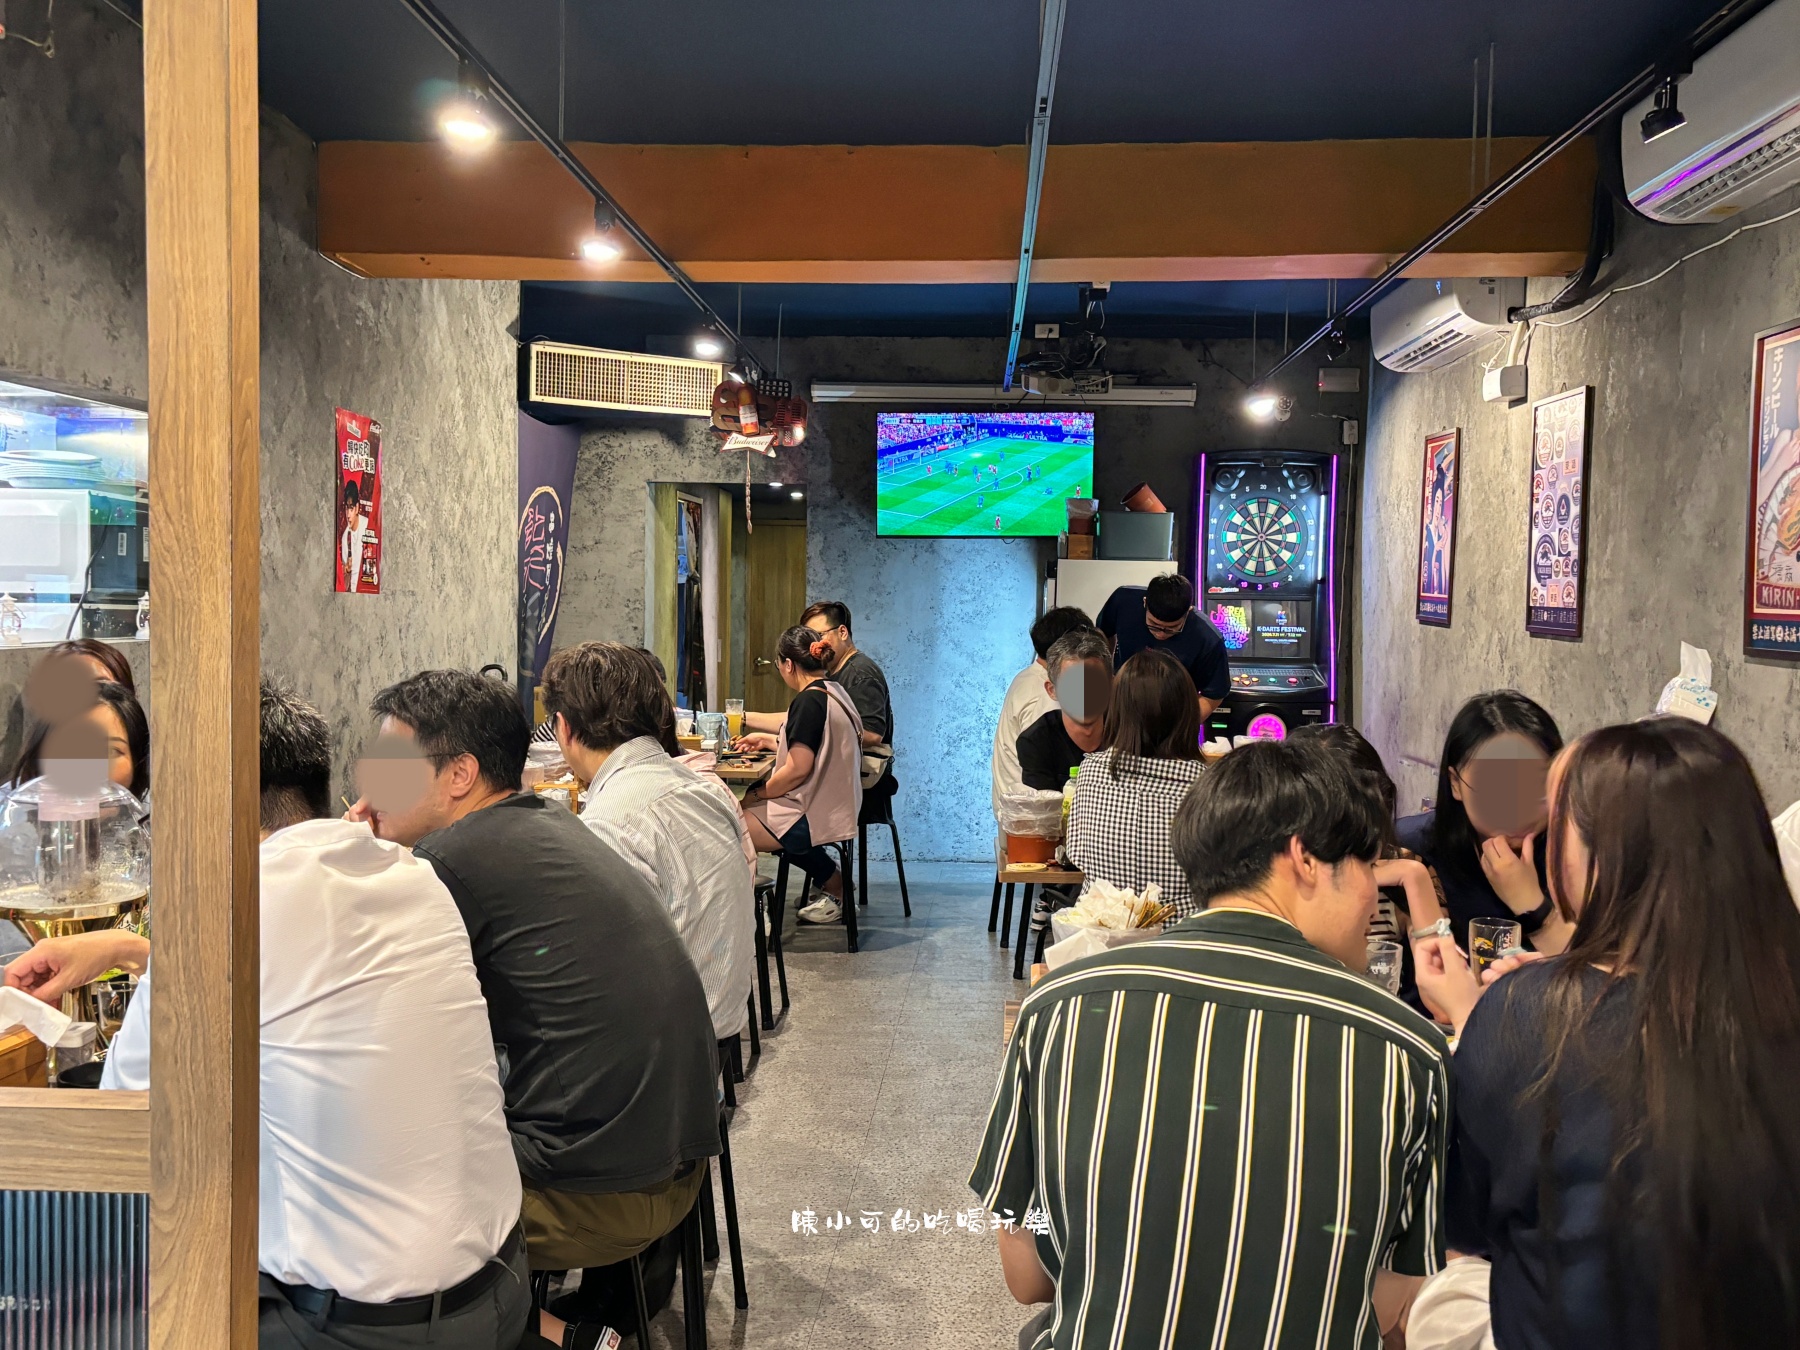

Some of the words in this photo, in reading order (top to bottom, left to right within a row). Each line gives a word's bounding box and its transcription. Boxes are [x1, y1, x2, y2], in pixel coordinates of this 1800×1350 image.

[728, 435, 769, 447] Budweiser
[1761, 585, 1796, 608] KIRIN
[1217, 603, 1245, 616] KOREA
